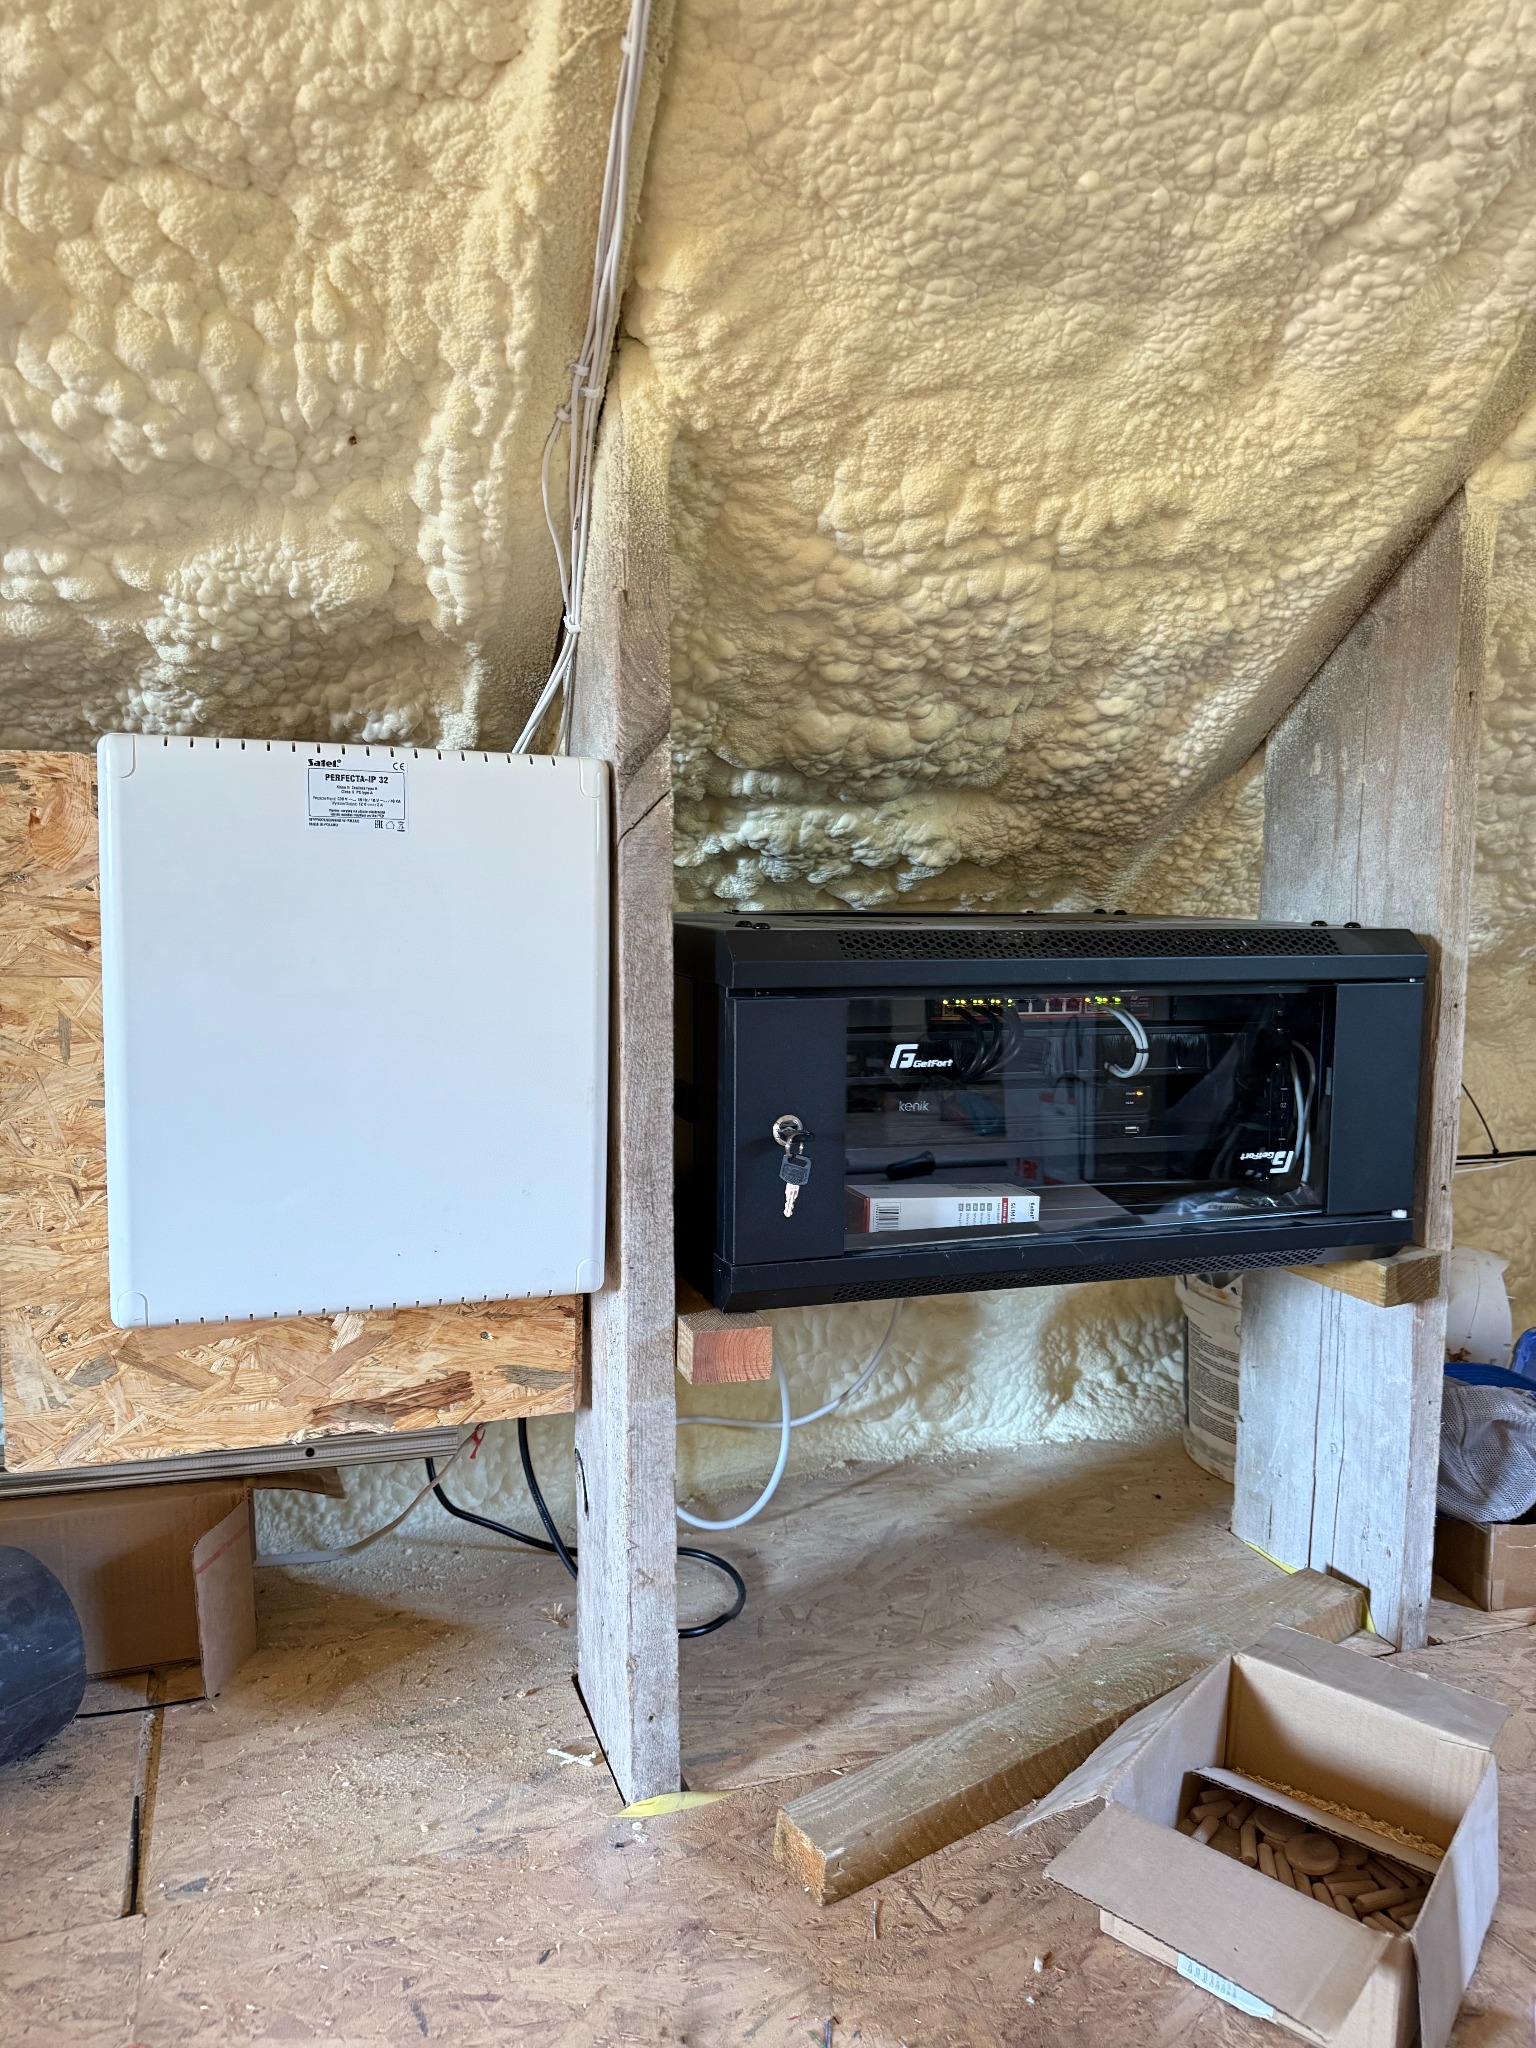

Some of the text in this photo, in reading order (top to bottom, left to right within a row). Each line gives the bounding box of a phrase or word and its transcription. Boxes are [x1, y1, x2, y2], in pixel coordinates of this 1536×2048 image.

[325, 774, 389, 784] PERFECTA-IP 32
[913, 1058, 954, 1068] GetFort
[898, 1100, 930, 1112] kenik
